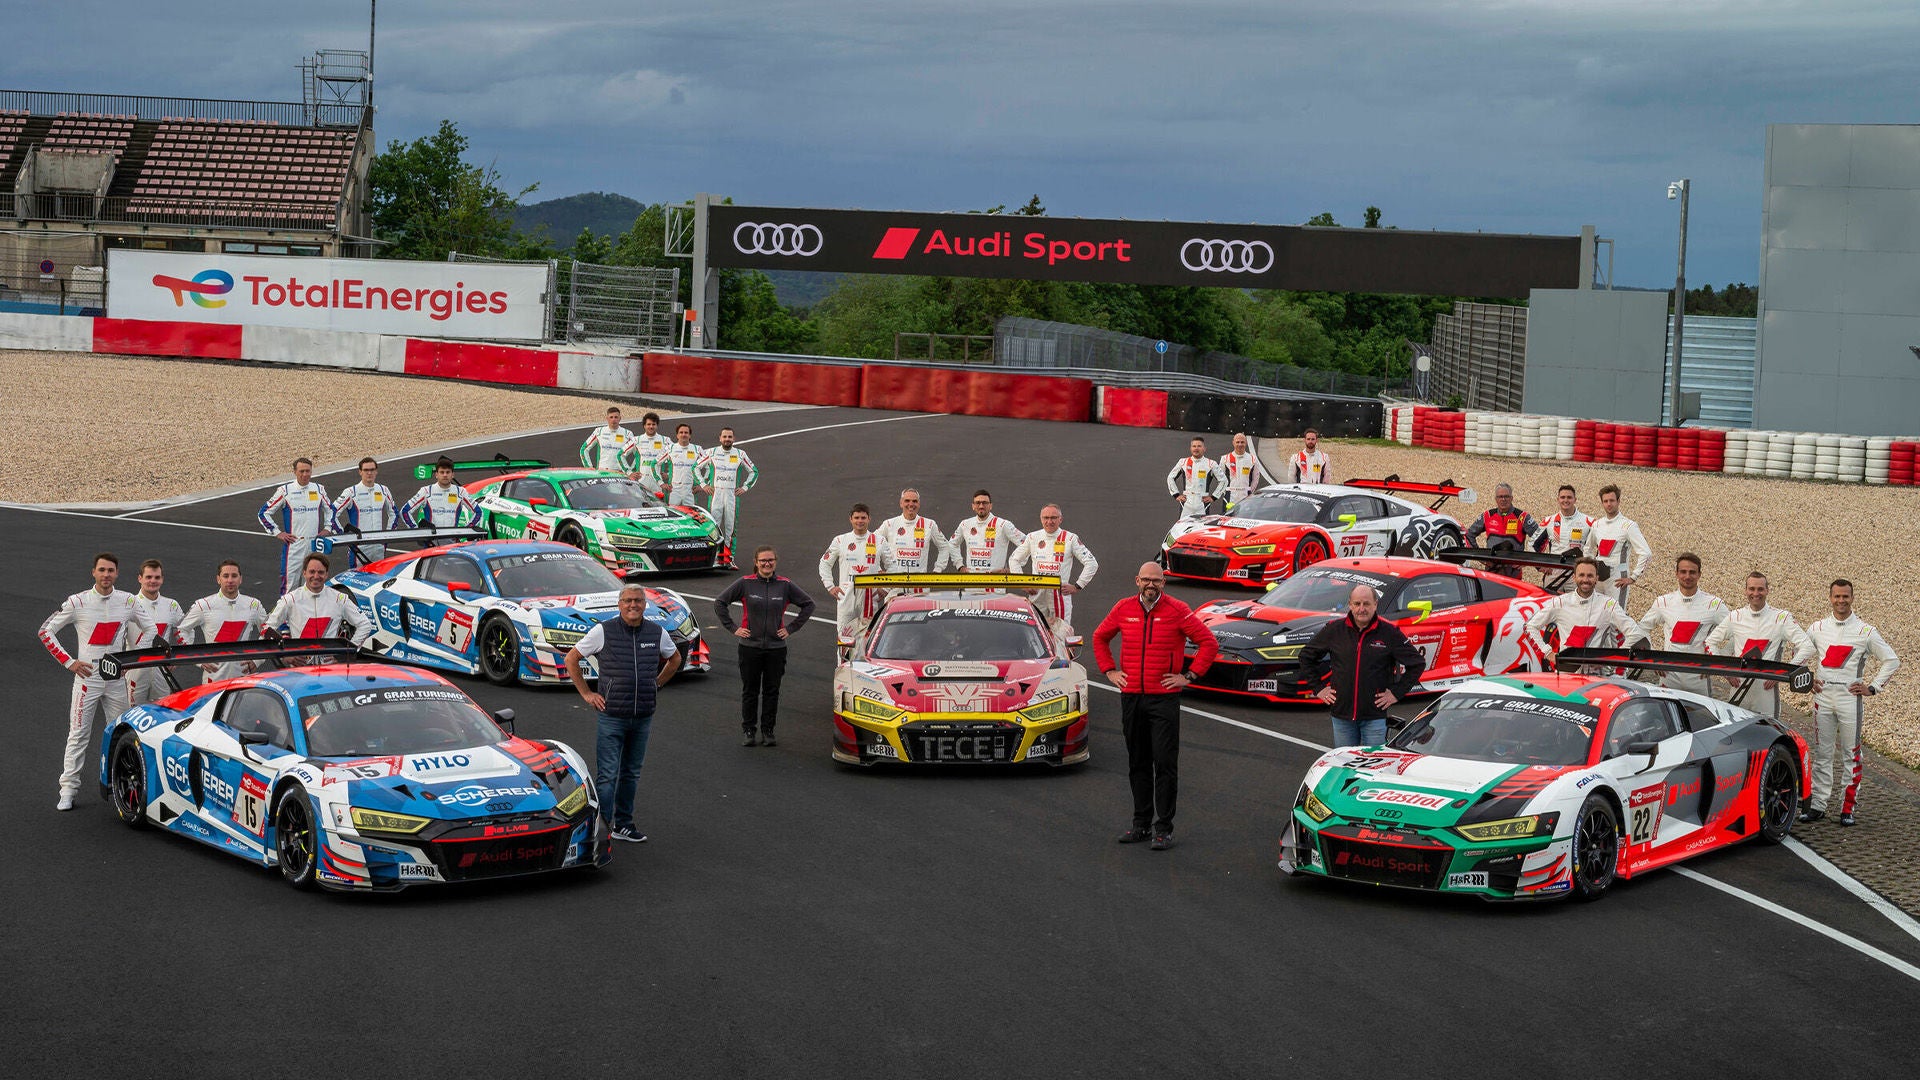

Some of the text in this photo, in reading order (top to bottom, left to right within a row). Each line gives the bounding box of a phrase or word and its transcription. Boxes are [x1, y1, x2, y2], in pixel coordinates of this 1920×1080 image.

[923, 228, 1131, 266] Audi Sport
[243, 274, 508, 321] TotalEnergies
[1232, 538, 1269, 546] COVENTRY
[971, 550, 991, 558] Veedol
[1038, 563, 1060, 571] Veedol
[955, 608, 984, 616] GRAN
[986, 609, 1029, 621] TURISMO
[449, 623, 457, 645] 5
[384, 690, 464, 702] GRAN TURISMO
[859, 687, 880, 701] TECE
[1037, 688, 1059, 701] TECE
[1504, 700, 1593, 723] GRAN TURISMO
[918, 736, 991, 759] TECE
[412, 754, 470, 771] HYLO
[1343, 757, 1384, 768] 22
[343, 766, 381, 778] 15
[1716, 771, 1742, 793] Sport
[437, 787, 541, 805] SCHERER
[1376, 790, 1446, 809] Castrol
[244, 795, 257, 829] 15
[1633, 807, 1650, 841] 22
[479, 845, 555, 863] Audi Sport
[1352, 854, 1431, 874] Audi Sport
